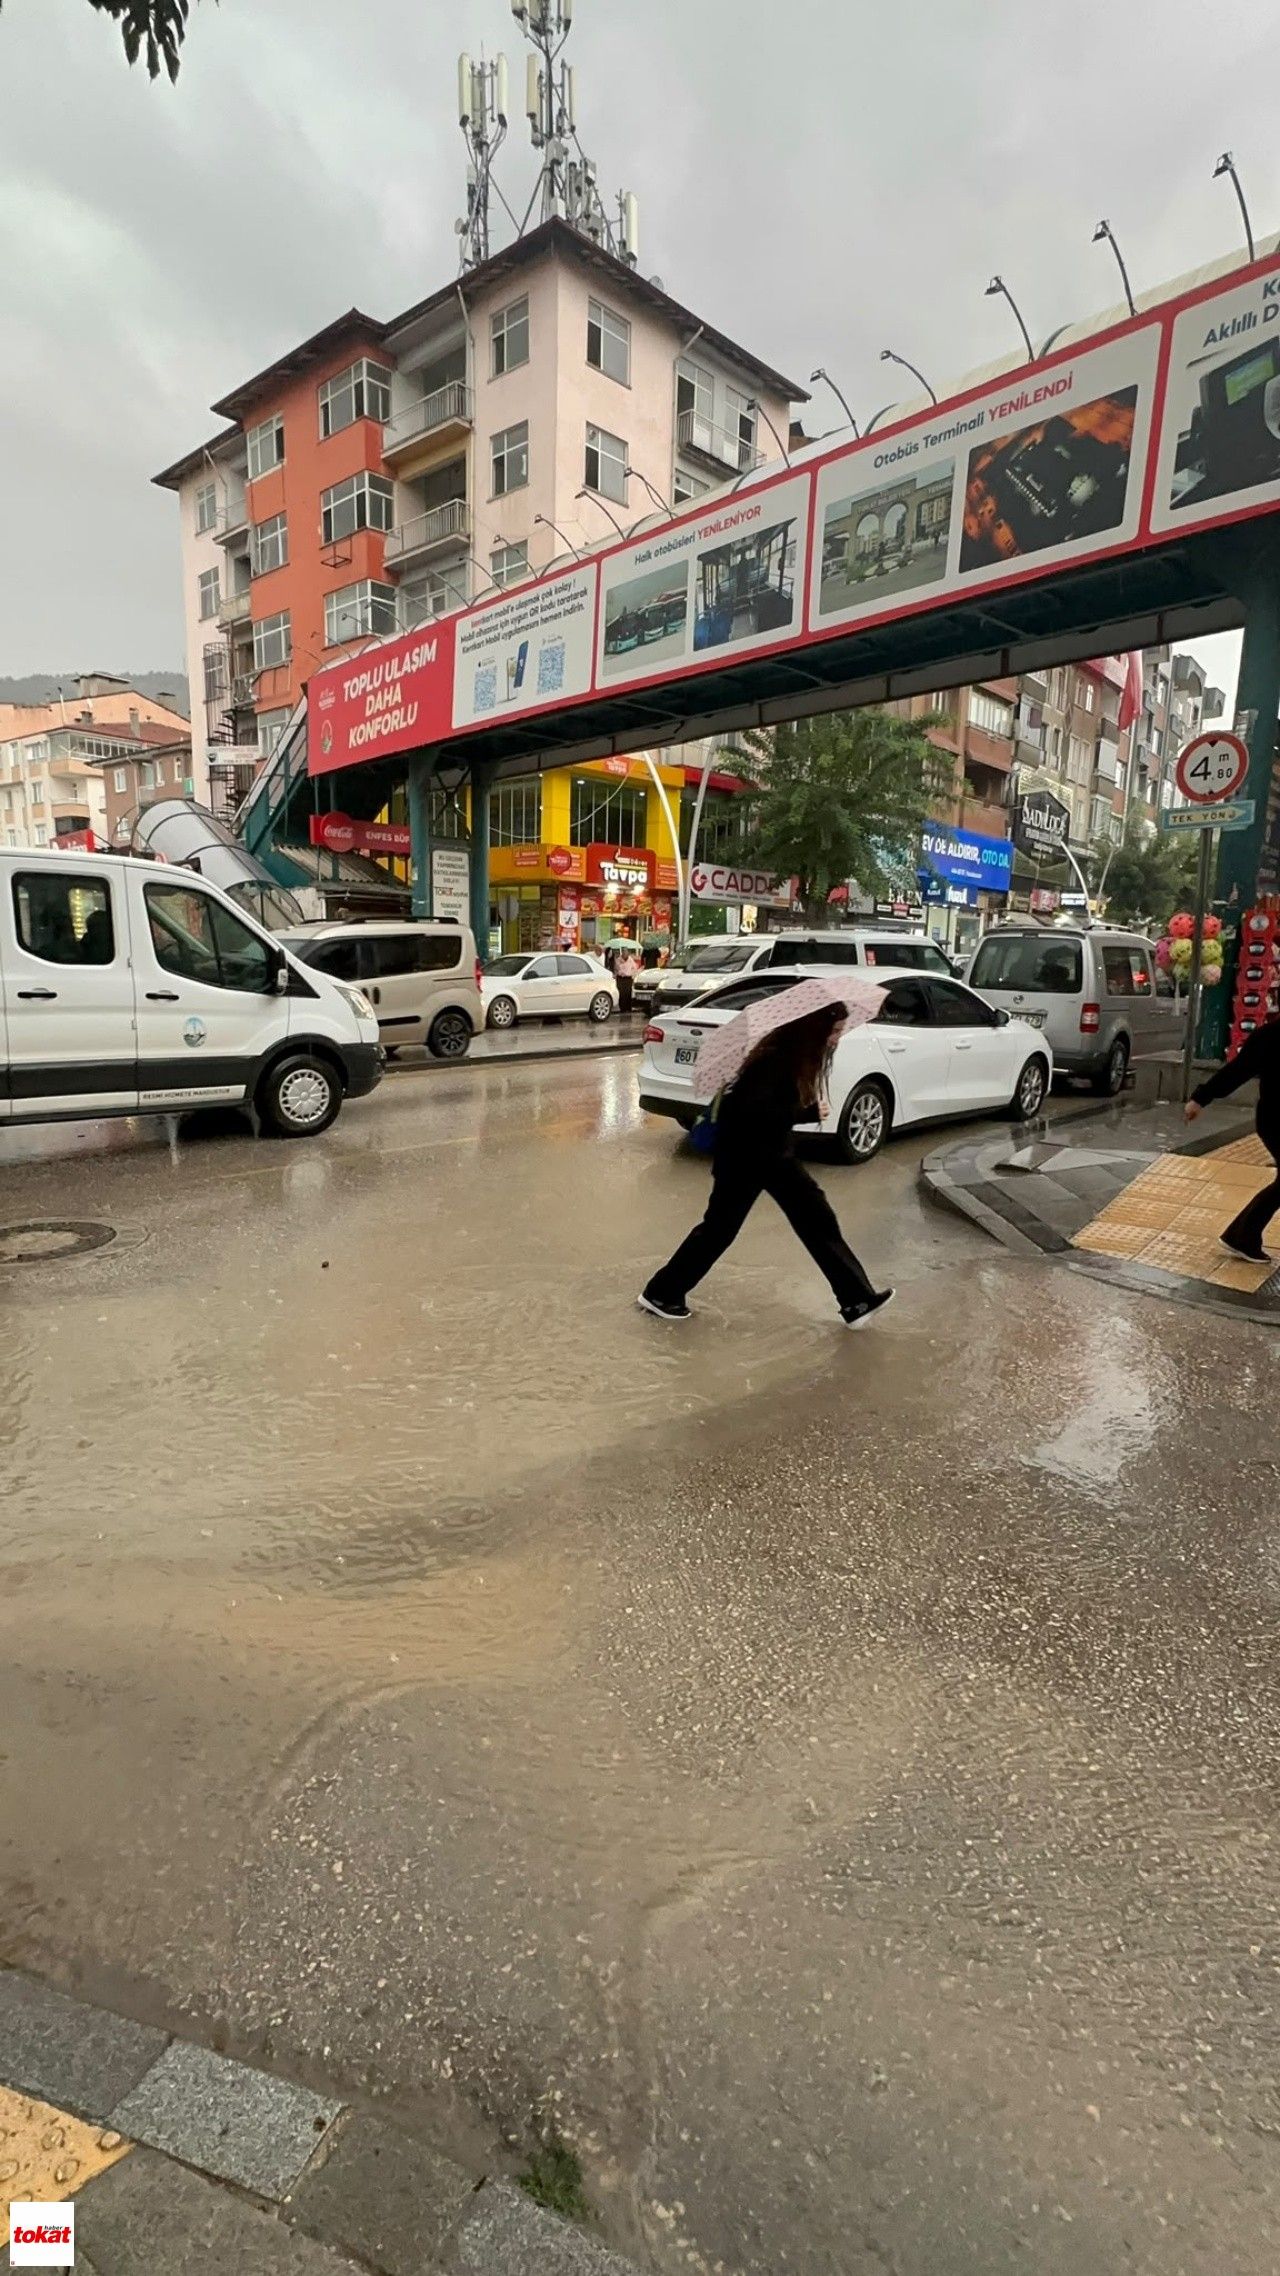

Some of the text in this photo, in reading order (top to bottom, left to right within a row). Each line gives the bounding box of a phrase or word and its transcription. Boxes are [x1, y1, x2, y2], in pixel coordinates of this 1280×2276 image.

[1263, 278, 1280, 299] K
[873, 371, 1074, 469] Otobüs Terminali YENİLENDİ
[634, 505, 762, 565] Halk otobüsleri YENİLENİYOR
[343, 665, 384, 703] TOPLU
[384, 638, 438, 683] ULAŞIM
[365, 682, 402, 718] DAHA
[348, 701, 419, 749] KONFORLU
[921, 834, 934, 852] EV
[981, 849, 998, 867] OTO
[600, 861, 648, 885] Tavpa
